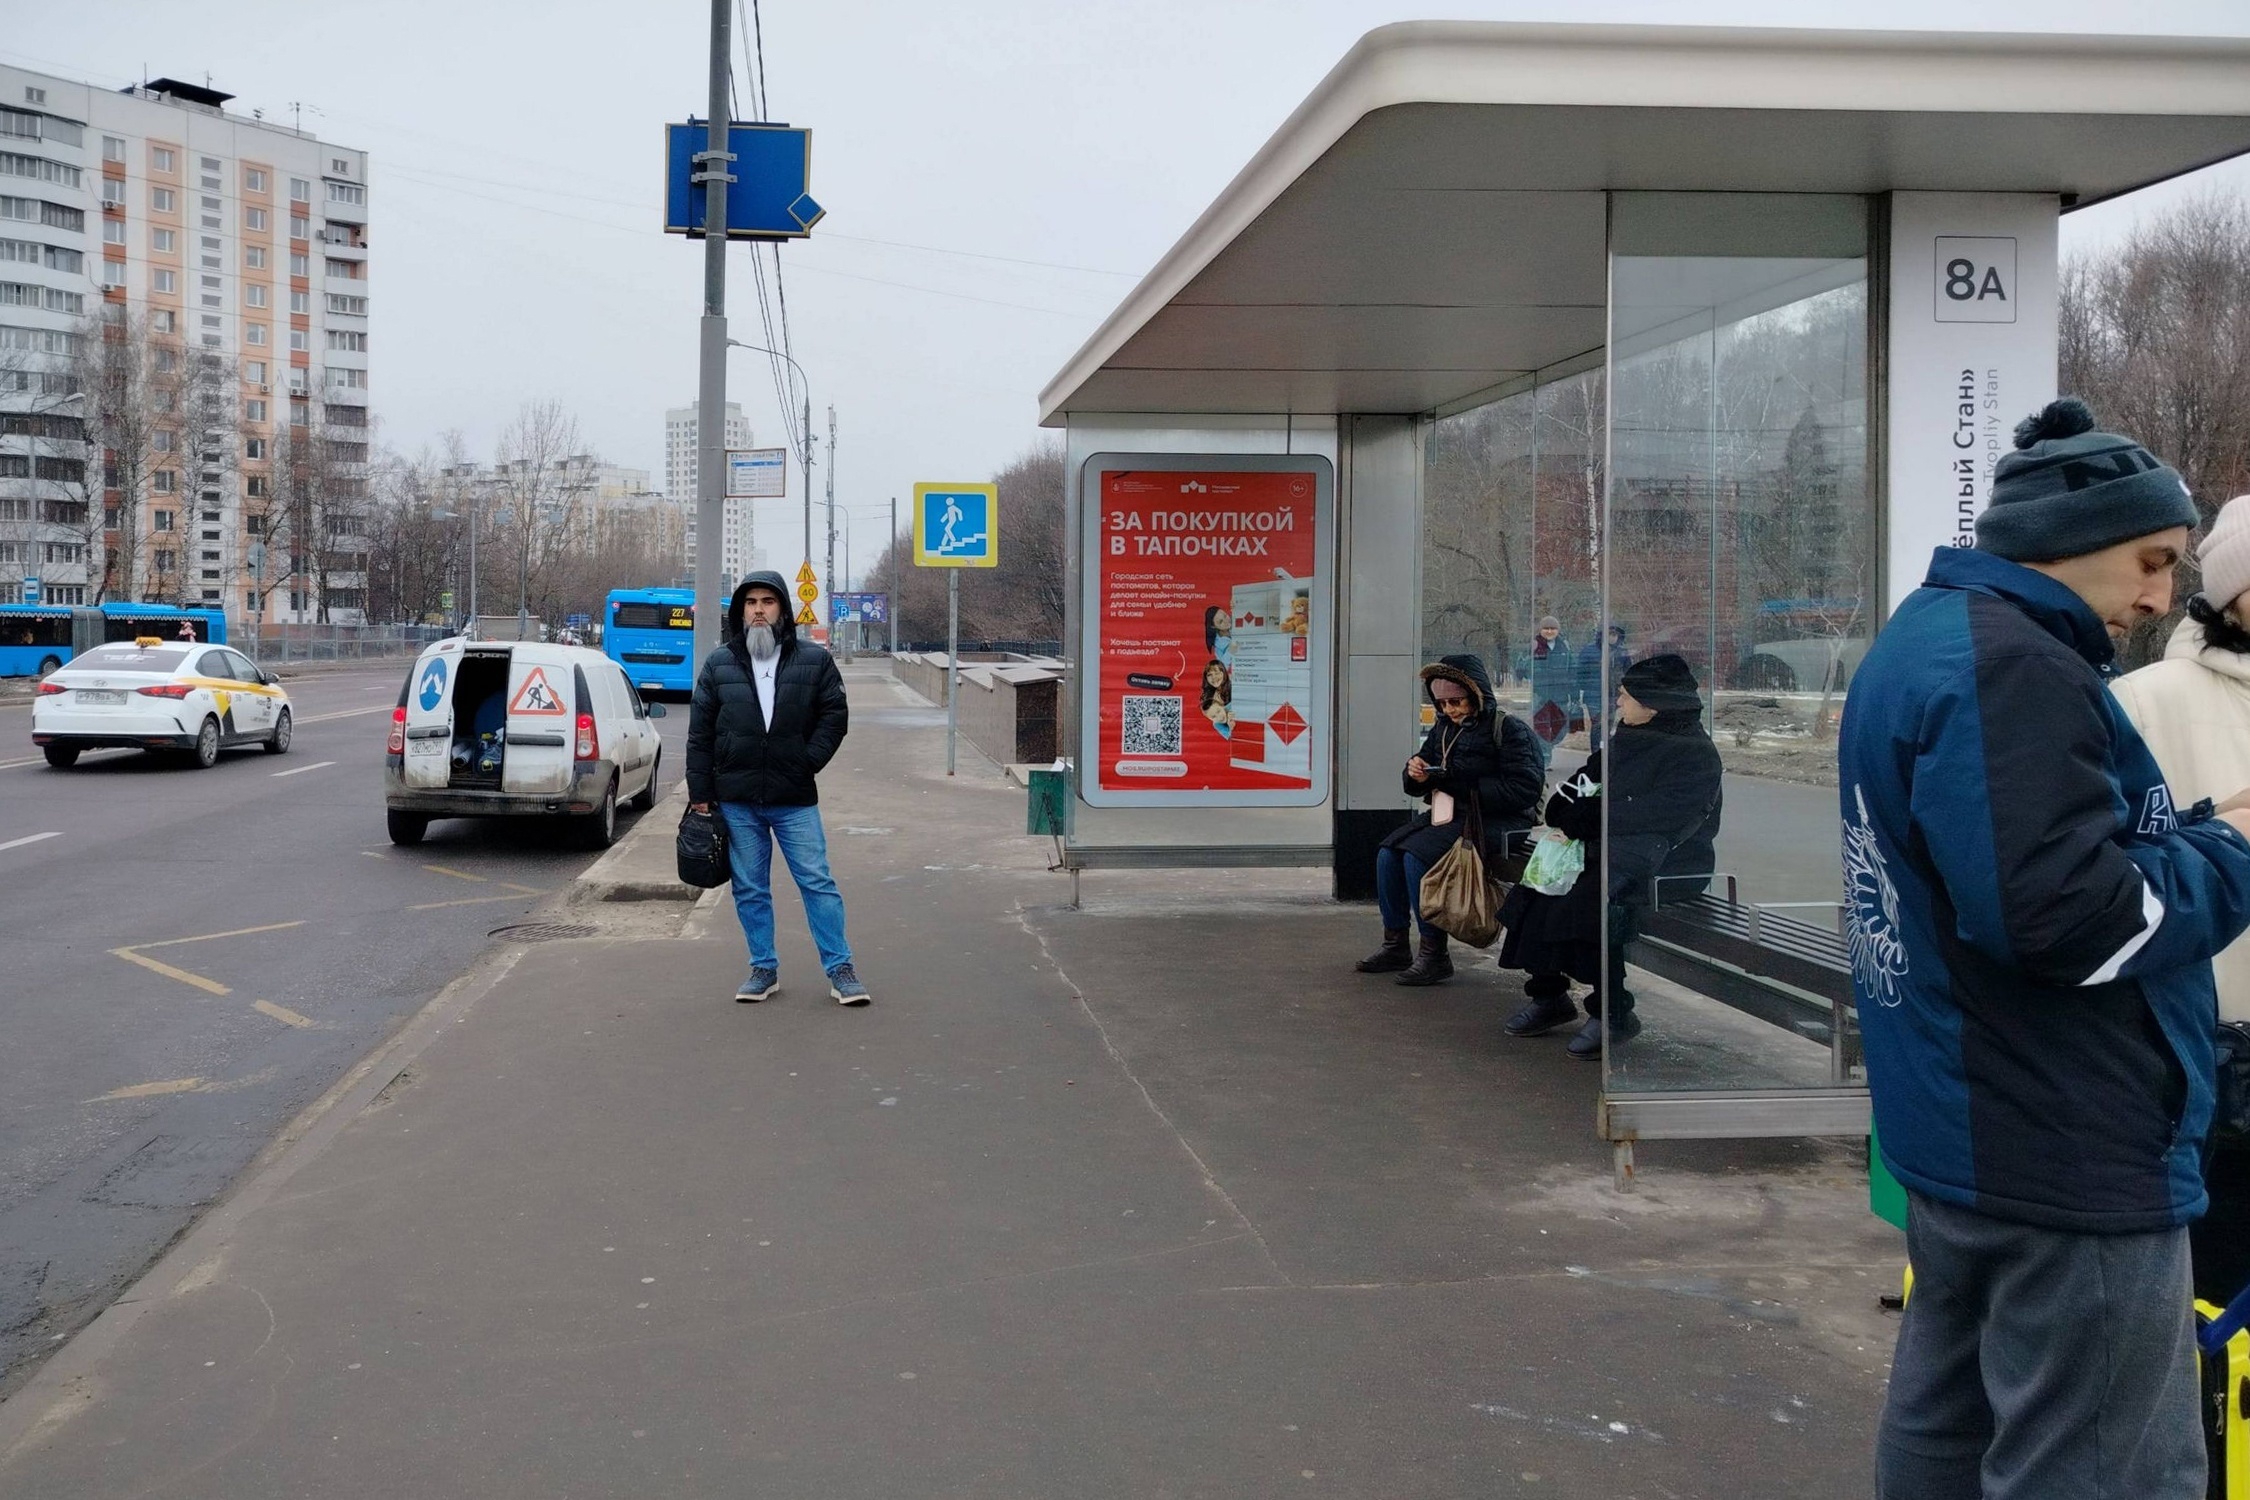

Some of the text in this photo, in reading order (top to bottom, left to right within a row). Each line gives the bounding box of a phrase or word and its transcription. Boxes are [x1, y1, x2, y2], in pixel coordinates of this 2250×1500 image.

[1945, 258, 2007, 301] 8А
[1983, 368, 1999, 410] Stan
[1953, 368, 1975, 550] ёплый Стан»
[1110, 506, 1294, 531] ЗА ПОКУПКОЙ
[1111, 536, 1268, 556] В ТАПОЧКАХ
[1110, 572, 1154, 581] Городская
[1162, 583, 1195, 591] которая
[802, 588, 814, 597] 40
[1140, 591, 1206, 600] онлайн-покупки
[1153, 601, 1187, 609] удобнее
[672, 608, 685, 617] 227
[1117, 610, 1144, 618] ближе
[1110, 638, 1141, 646] Хочешь
[1116, 647, 1160, 656] подъезде?
[2137, 784, 2179, 834] R
